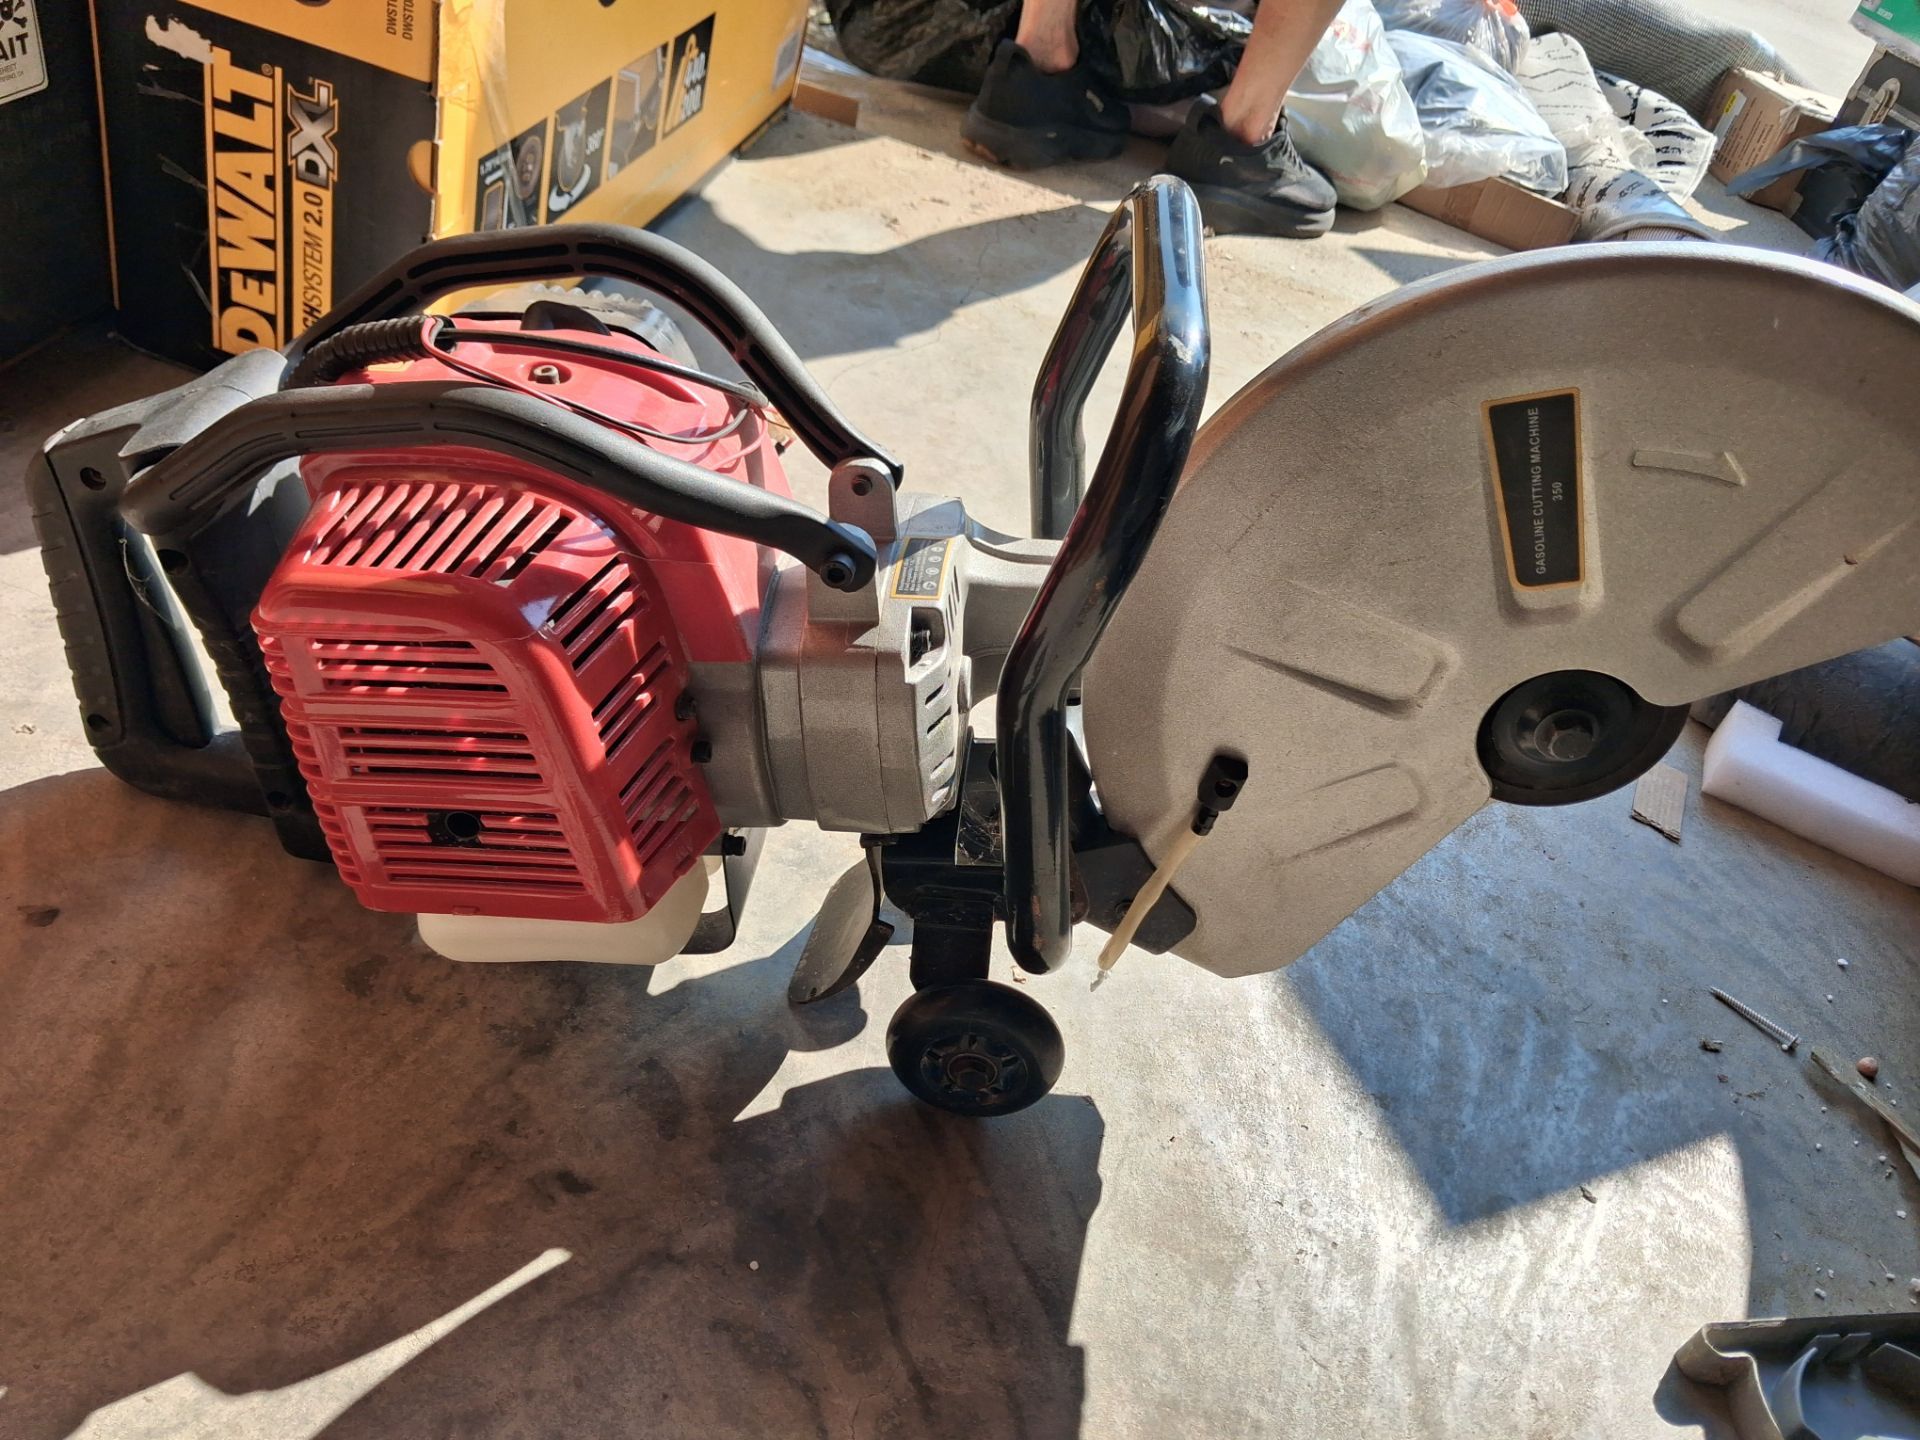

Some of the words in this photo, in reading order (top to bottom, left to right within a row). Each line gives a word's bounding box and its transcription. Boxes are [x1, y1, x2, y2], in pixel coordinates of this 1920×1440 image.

[386, 0, 397, 35] DWST
[288, 79, 338, 189] DXL
[213, 47, 276, 353] DEWALT
[303, 191, 323, 228] 2.0
[1528, 407, 1541, 464] MACHINE
[1531, 466, 1544, 516] CUTTING
[1552, 481, 1563, 502] 350
[1534, 518, 1547, 574] GASOLINE
